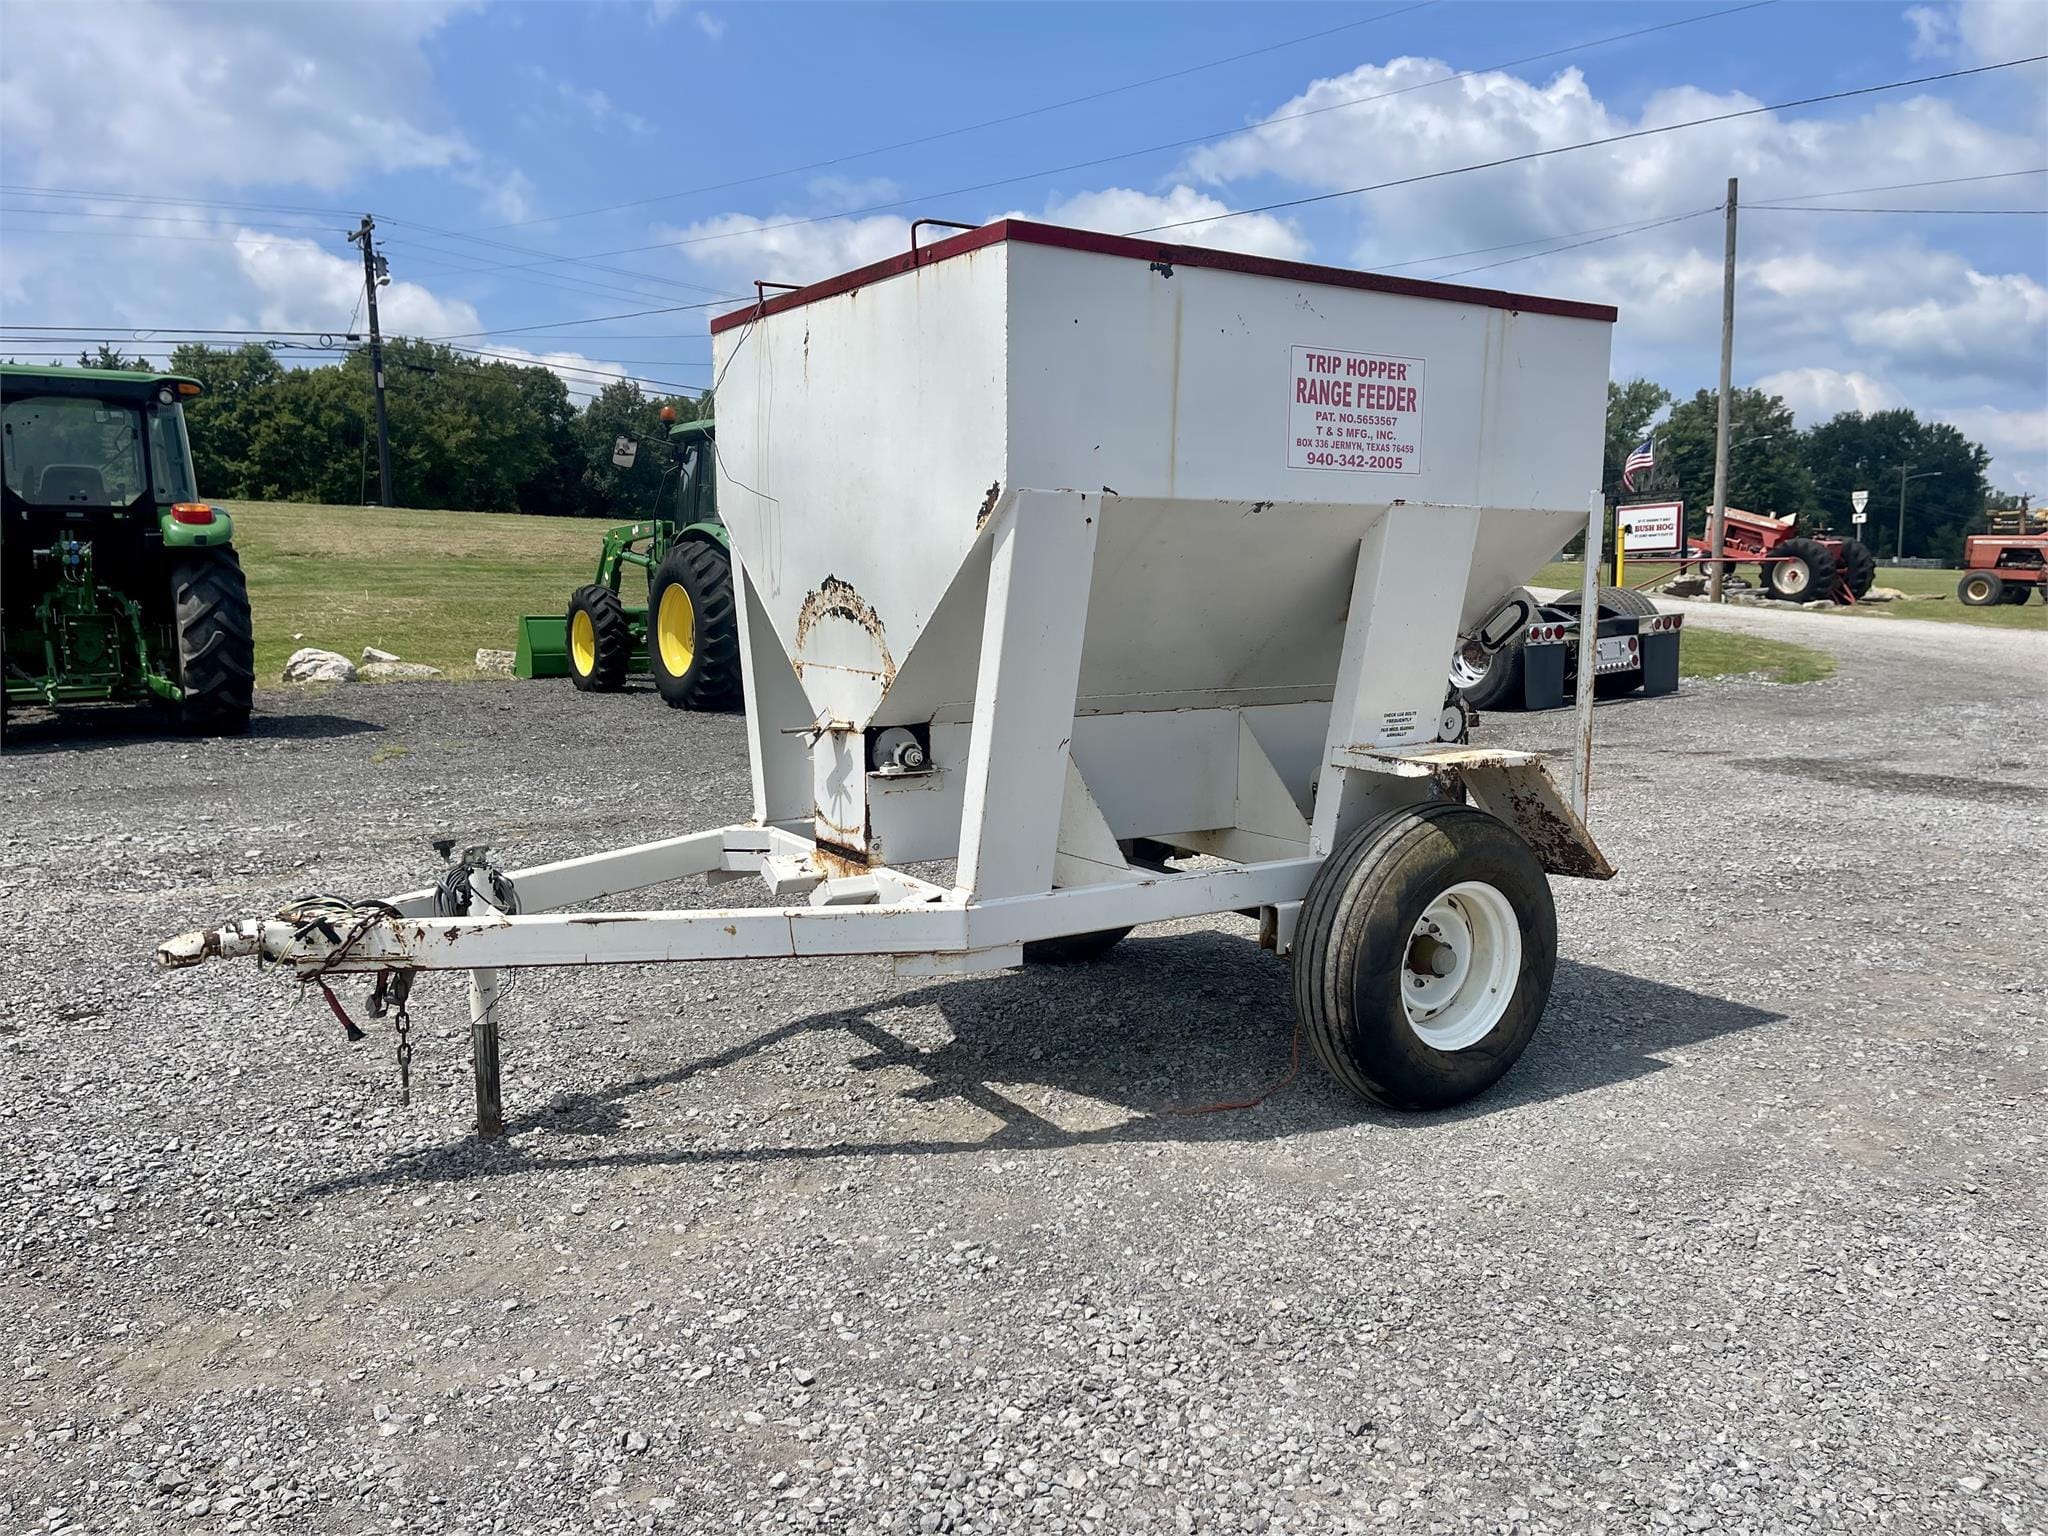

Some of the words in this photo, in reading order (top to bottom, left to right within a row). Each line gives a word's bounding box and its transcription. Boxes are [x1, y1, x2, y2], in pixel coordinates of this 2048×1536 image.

[1306, 353, 1342, 374] TRIP
[1346, 358, 1407, 381] HOPPER
[1296, 377, 1353, 408] RANGE
[1357, 383, 1417, 413] FEEDER
[1316, 411, 1336, 422] PAT.
[1339, 413, 1398, 427] NO.5653567
[1316, 426, 1323, 436] T
[1326, 426, 1333, 437] &
[1336, 427, 1343, 437] S
[1346, 428, 1373, 441] MFG.,
[1376, 430, 1397, 441] INC.
[1296, 438, 1313, 448] BOX
[1315, 439, 1329, 449] 336
[1331, 440, 1364, 453] JERMYN,
[1366, 443, 1390, 452] TEXAS
[1392, 444, 1414, 454] 76459
[1307, 452, 1403, 469] 940-342-2005
[1635, 524, 1654, 532] BUSH
[1656, 523, 1674, 531] HOG
